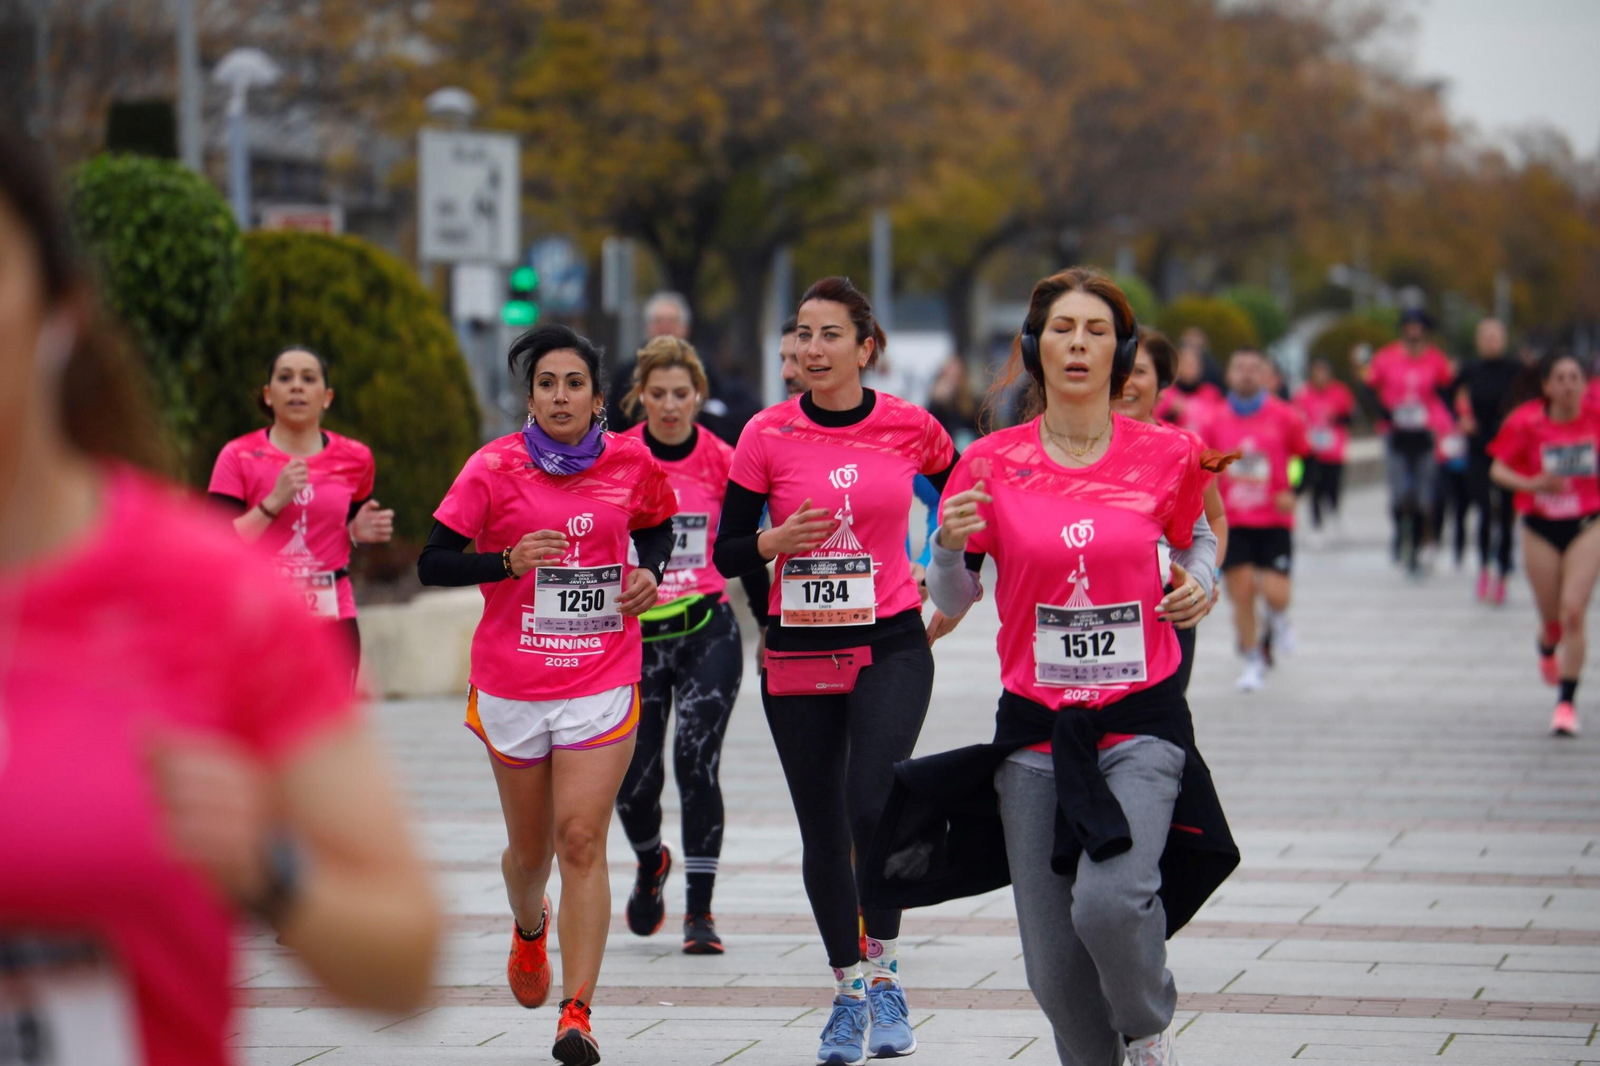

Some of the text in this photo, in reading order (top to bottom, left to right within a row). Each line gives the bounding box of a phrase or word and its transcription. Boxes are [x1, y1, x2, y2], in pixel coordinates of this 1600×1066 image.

[557, 588, 605, 612] 1250
[801, 580, 850, 603] 1734
[520, 633, 602, 650] RUNNING
[1060, 630, 1115, 658] 1512
[544, 657, 579, 668] 2023
[1063, 688, 1100, 702] 2023
